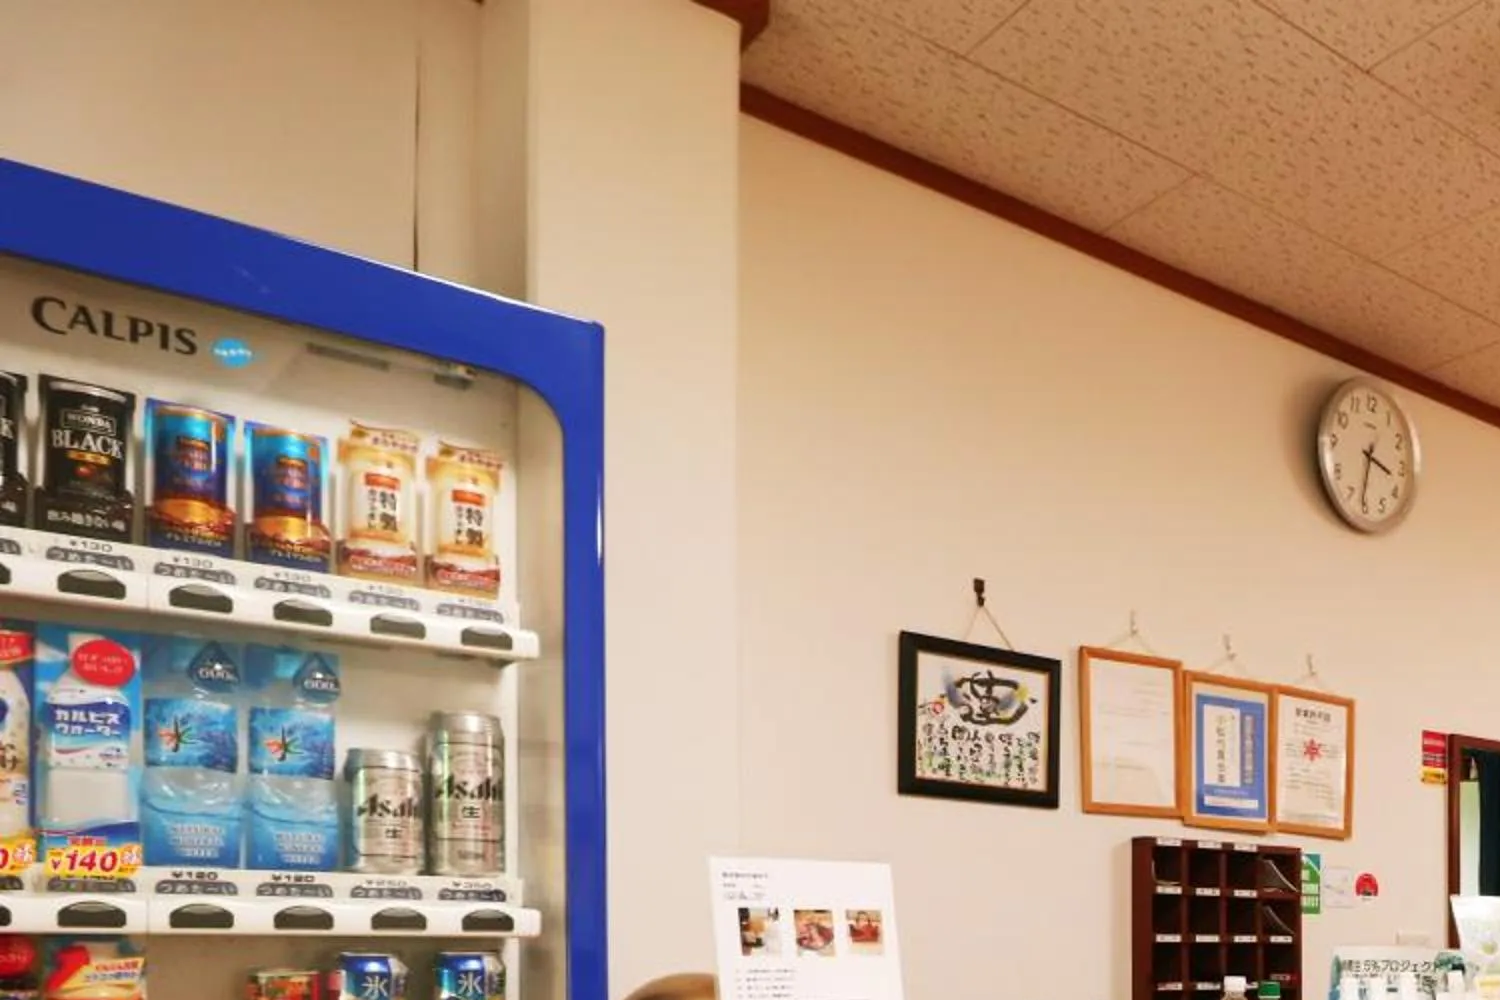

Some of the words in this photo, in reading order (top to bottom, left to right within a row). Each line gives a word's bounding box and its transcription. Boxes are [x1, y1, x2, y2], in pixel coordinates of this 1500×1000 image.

[31, 296, 198, 356] CALPIS
[1350, 396, 1361, 413] 11
[1366, 394, 1378, 413] 12
[1337, 411, 1349, 430] 10
[1386, 410, 1391, 426] 1
[51, 429, 124, 460] BLACK
[1329, 433, 1339, 448] 9
[1394, 432, 1403, 451] 2
[1333, 462, 1342, 481] 8
[1397, 460, 1405, 478] 3
[1345, 485, 1356, 500] 7
[1391, 485, 1399, 499] 4
[1377, 498, 1387, 514] 5
[69, 538, 114, 552] ¥130
[172, 556, 214, 569] ¥130
[54, 708, 122, 726] カルピス
[55, 722, 122, 737] ウォーター
[461, 805, 481, 819] 生
[51, 850, 118, 874] ¥140
[361, 975, 389, 998] 氷
[457, 973, 482, 995] 氷
